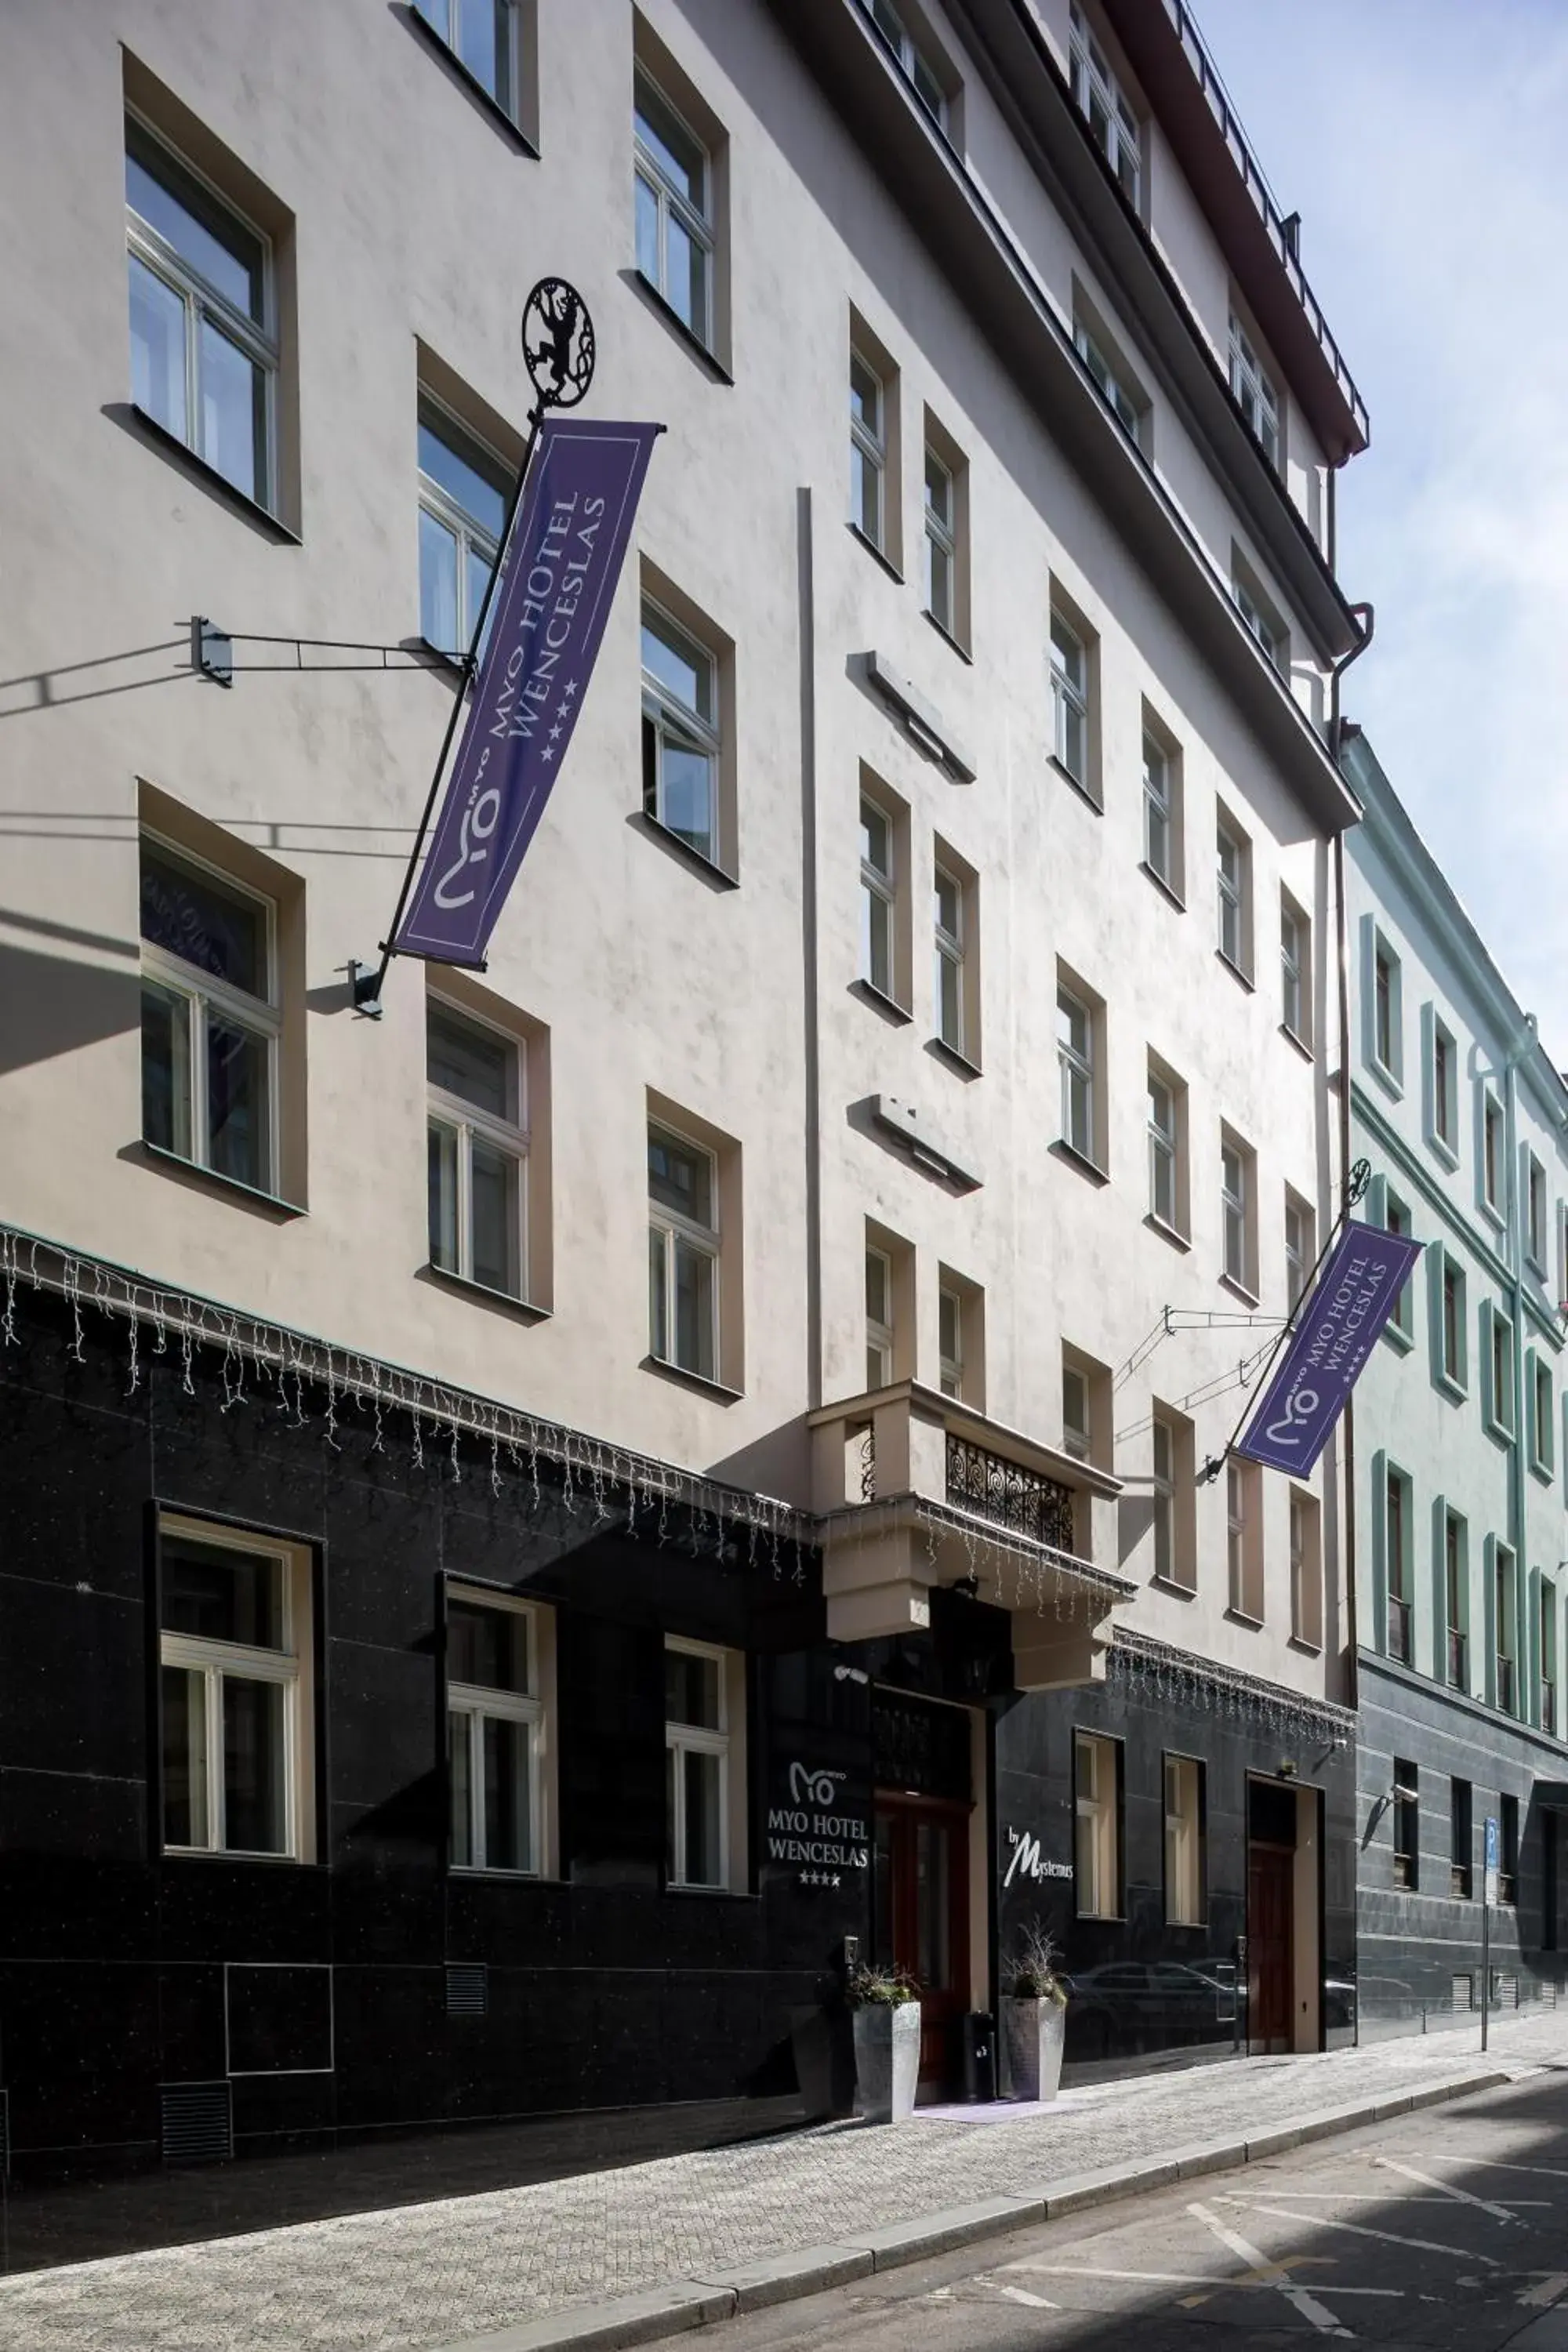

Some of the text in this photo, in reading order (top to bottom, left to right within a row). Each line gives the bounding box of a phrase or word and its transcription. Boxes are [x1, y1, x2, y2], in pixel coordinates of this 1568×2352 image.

[489, 492, 578, 738] MYO HOTEL
[510, 497, 605, 739] WENCESLAS
[1307, 1258, 1370, 1367] MYO HOTEL
[1324, 1262, 1387, 1370] WENCESLAS
[768, 1809, 869, 1840] MYO HOTEL
[768, 1836, 868, 1867] WENCESLAS
[1009, 1826, 1019, 1849] by
